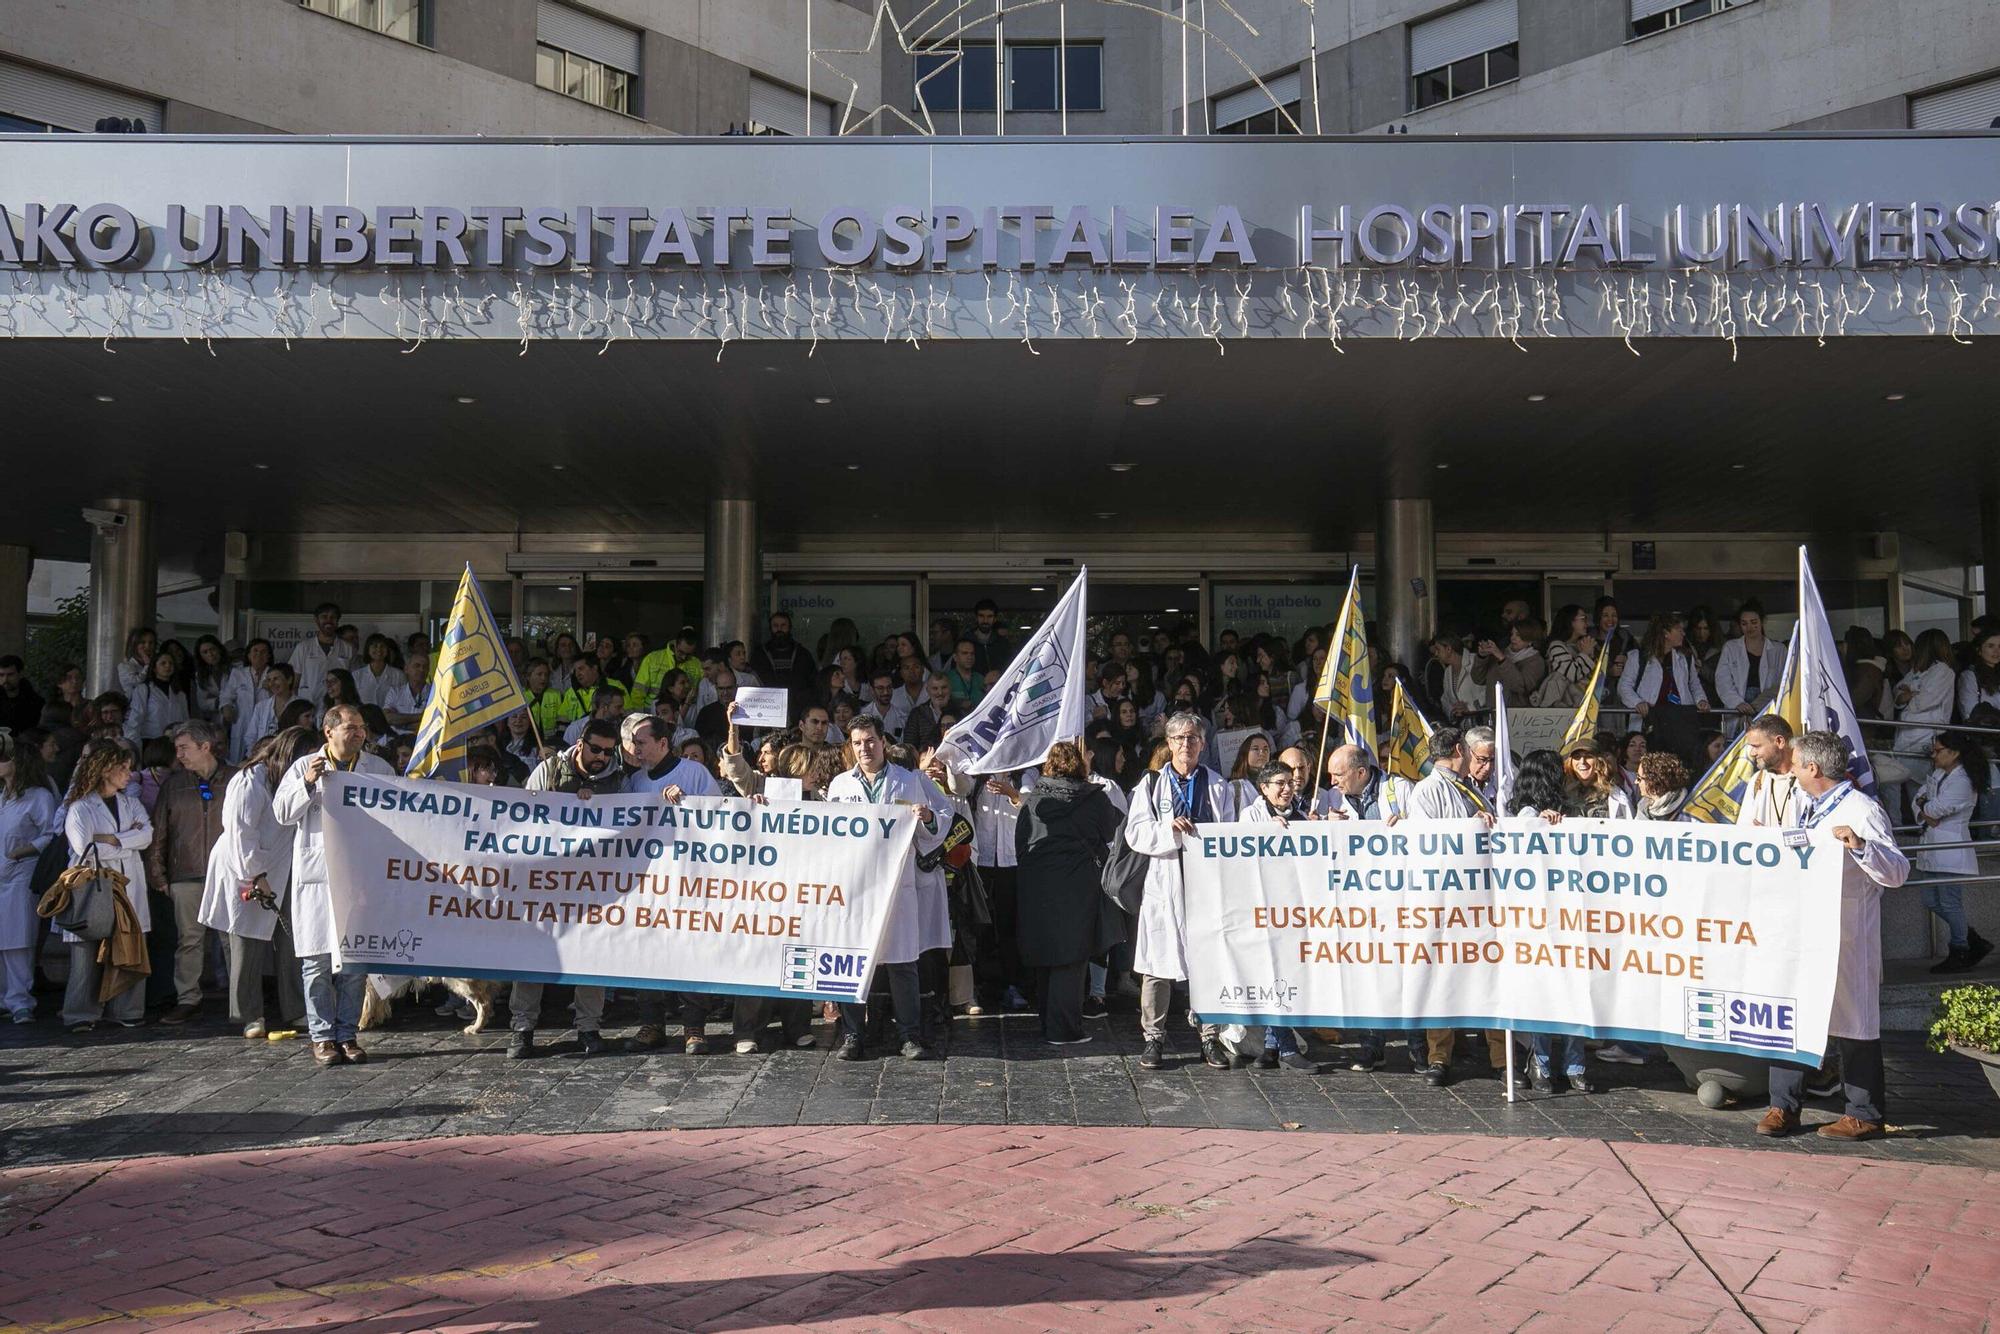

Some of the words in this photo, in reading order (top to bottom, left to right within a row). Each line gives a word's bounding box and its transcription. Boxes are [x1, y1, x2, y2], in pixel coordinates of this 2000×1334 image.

[166, 203, 792, 266] UNIBERTSITATE
[818, 206, 1258, 266] OSPITALEA
[1301, 203, 1656, 264] HOSPITAL
[1676, 200, 2000, 263] UNIVERS
[1224, 594, 1263, 608] Kerik
[1267, 594, 1321, 609] gabeko
[1224, 608, 1281, 619] eremua
[268, 627, 302, 640] Kerik
[342, 785, 480, 822] EUSKADI,
[490, 800, 550, 825] POR
[560, 806, 602, 826] UN
[611, 805, 752, 832] ESTATUTO
[761, 808, 869, 838] MÉDICO
[878, 818, 897, 839] Y
[464, 830, 665, 860] FACULTATIVO
[672, 840, 778, 866] PROPIO
[1203, 835, 1338, 860] EUSKADI,
[1349, 834, 1409, 856] POR
[1419, 833, 1463, 856] UN
[1475, 831, 1634, 858] ESTATUTO
[1645, 832, 1781, 867] MÉDICO
[1791, 845, 1816, 870] Y
[386, 858, 518, 892] EUSKADI,
[528, 870, 670, 896] ESTATUTU
[679, 875, 788, 903] MEDIKO
[796, 883, 846, 907] ETA
[1329, 868, 1536, 891] FACULTATIVO
[1547, 868, 1668, 898] PROPIO
[427, 895, 626, 927] FAKULTATIBO
[635, 906, 724, 933] BATEN
[731, 913, 802, 938] ALDE
[1254, 906, 1386, 932] EUSKADI,
[1397, 906, 1547, 930] ESTATUTU
[1560, 907, 1684, 940] MEDIKO
[1696, 917, 1758, 947] ETA
[1300, 941, 1505, 965] FAKULTATIBO
[1515, 942, 1611, 971] BATEN
[1622, 949, 1705, 980] ALDE
[1729, 999, 1794, 1030] SME
